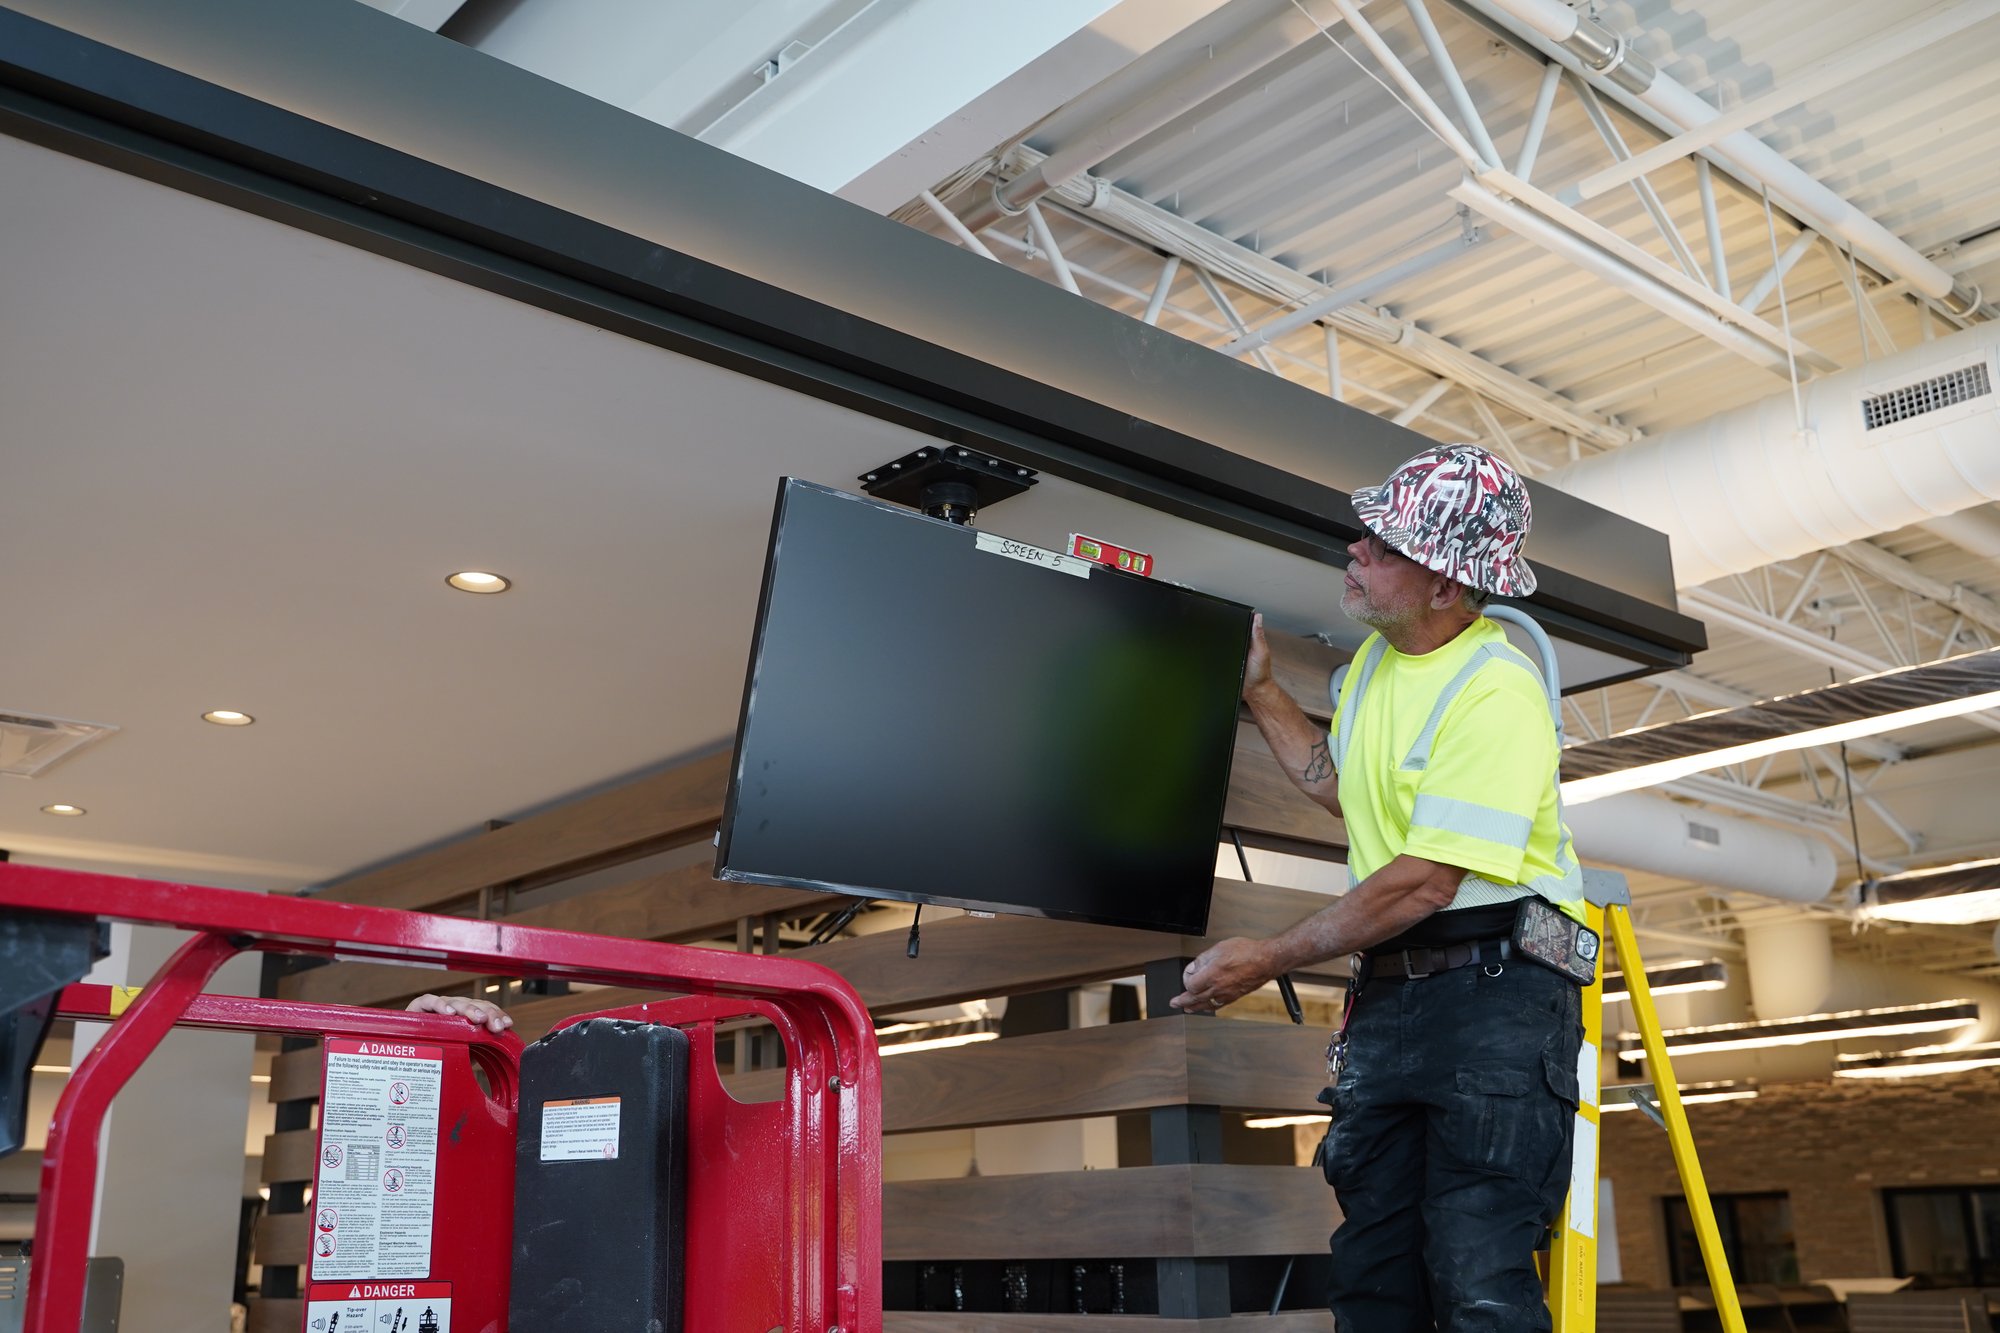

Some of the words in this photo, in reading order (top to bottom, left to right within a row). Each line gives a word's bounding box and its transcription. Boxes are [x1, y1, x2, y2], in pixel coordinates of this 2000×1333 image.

[1000, 540, 1044, 561] SCREEN
[1052, 555, 1064, 567] 5
[372, 1043, 416, 1057] DANGER
[364, 1284, 415, 1298] DANGER
